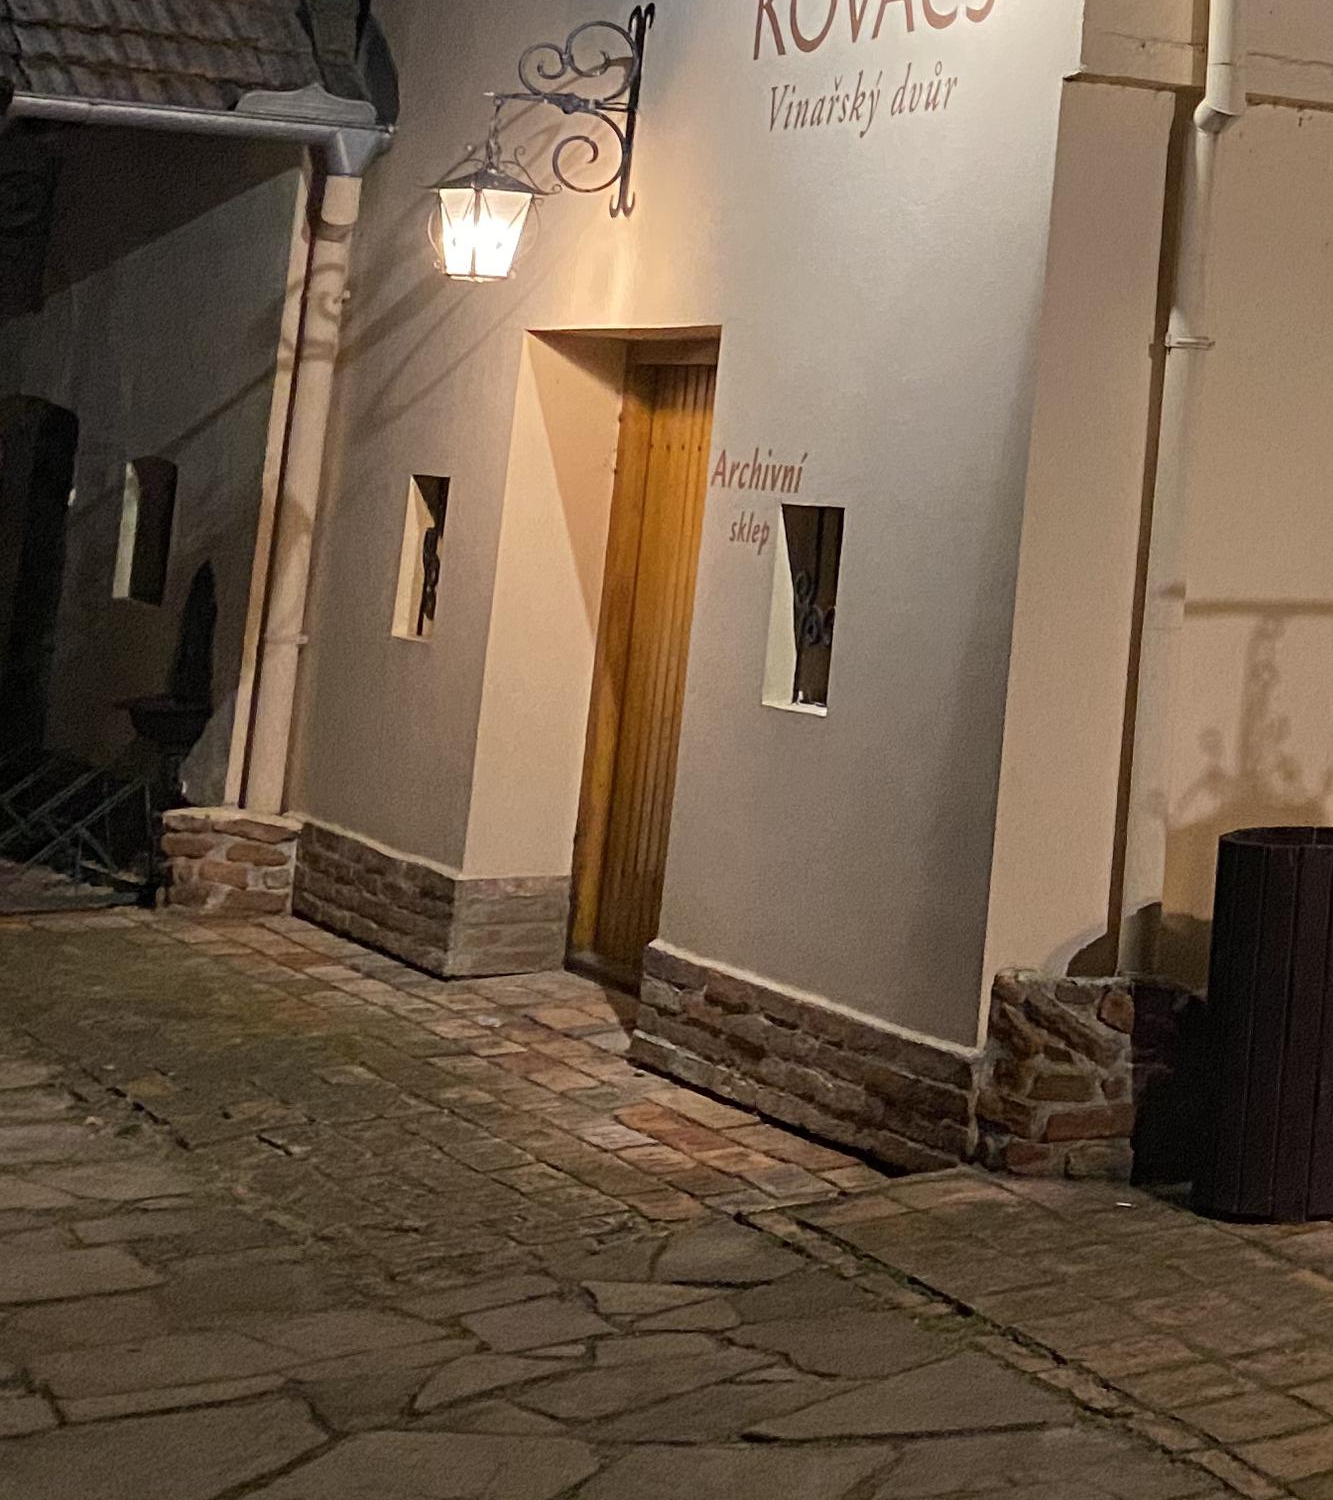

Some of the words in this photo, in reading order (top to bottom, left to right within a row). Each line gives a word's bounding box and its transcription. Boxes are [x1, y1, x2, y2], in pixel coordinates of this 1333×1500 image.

[768, 69, 884, 138] Vinařský
[889, 60, 960, 118] dvůr
[710, 446, 808, 494] Archivní
[728, 510, 771, 556] sklep
